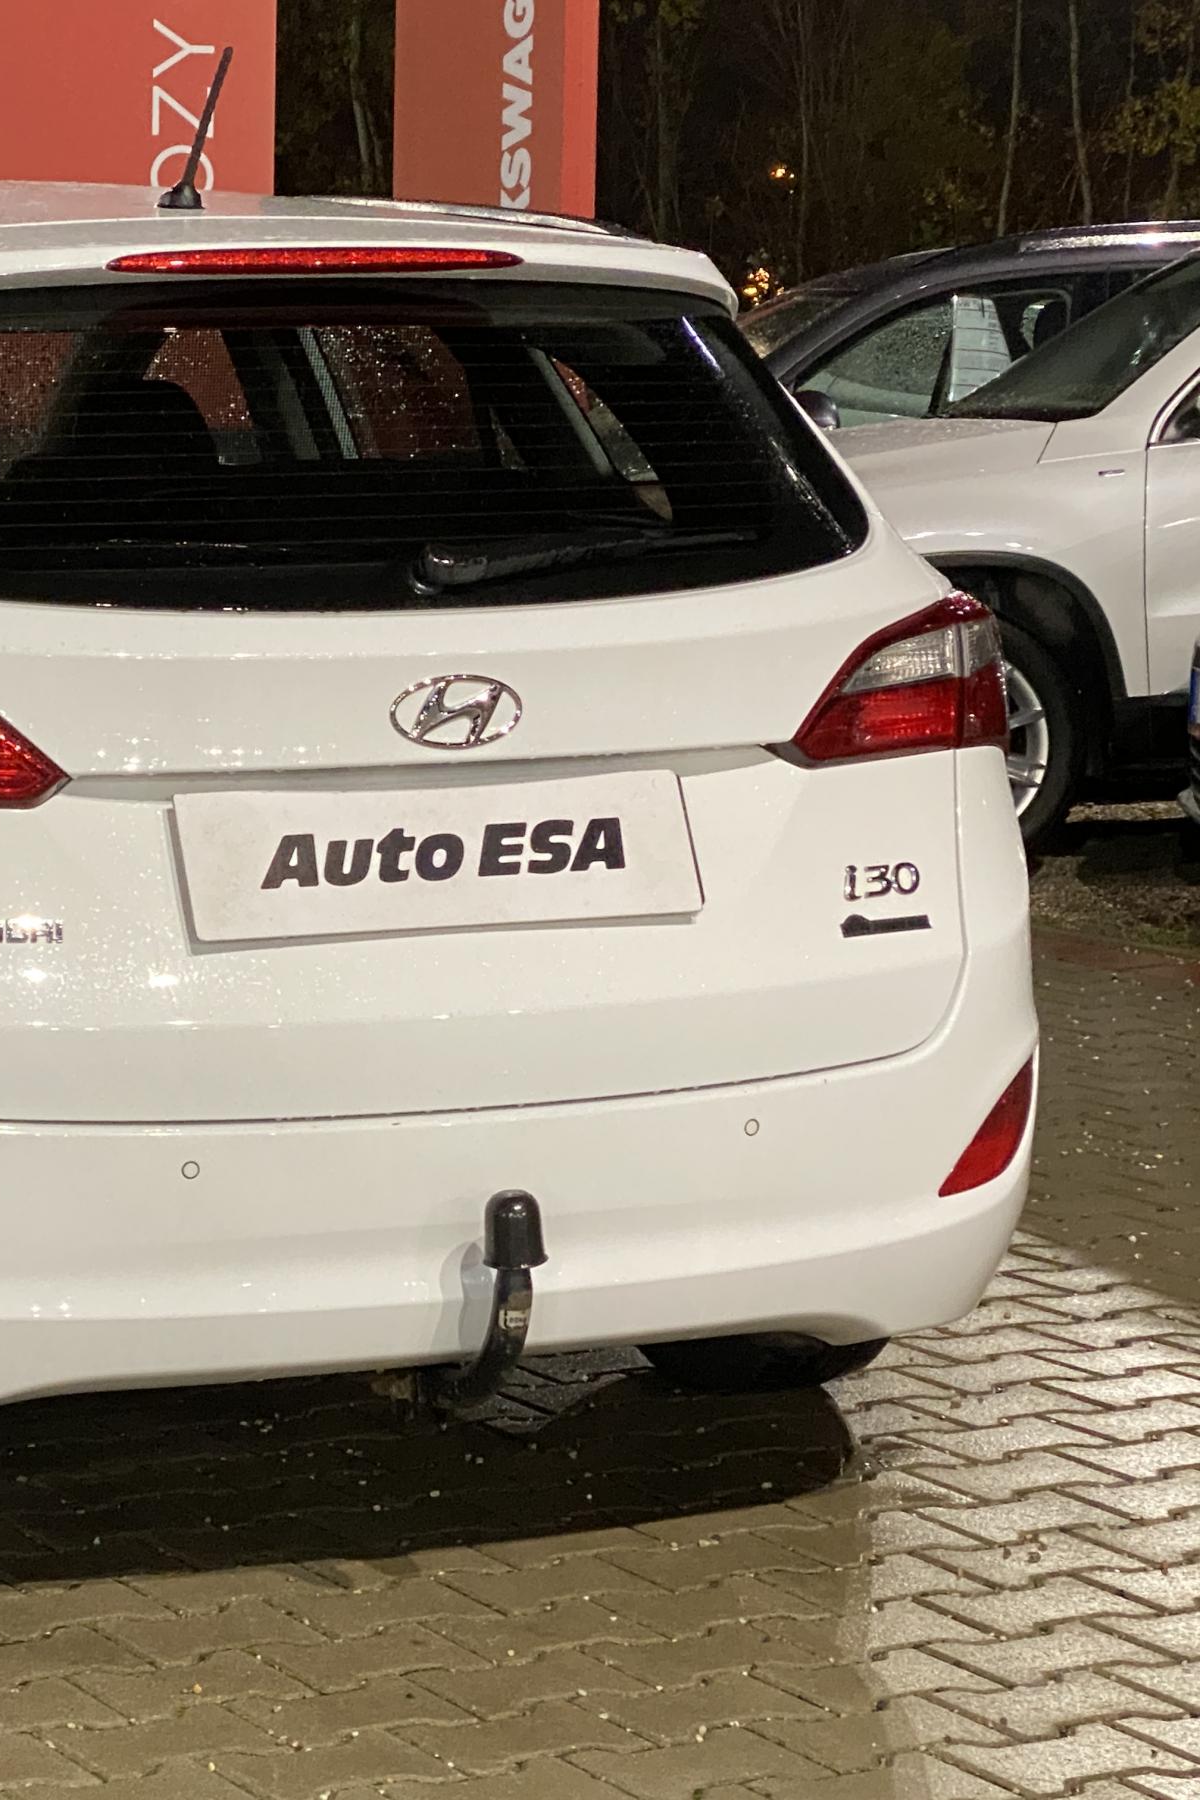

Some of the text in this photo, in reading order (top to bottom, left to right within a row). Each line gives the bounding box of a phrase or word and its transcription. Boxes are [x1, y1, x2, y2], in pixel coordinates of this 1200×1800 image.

[261, 817, 626, 889] Auto ESA
[843, 862, 920, 902] i30
